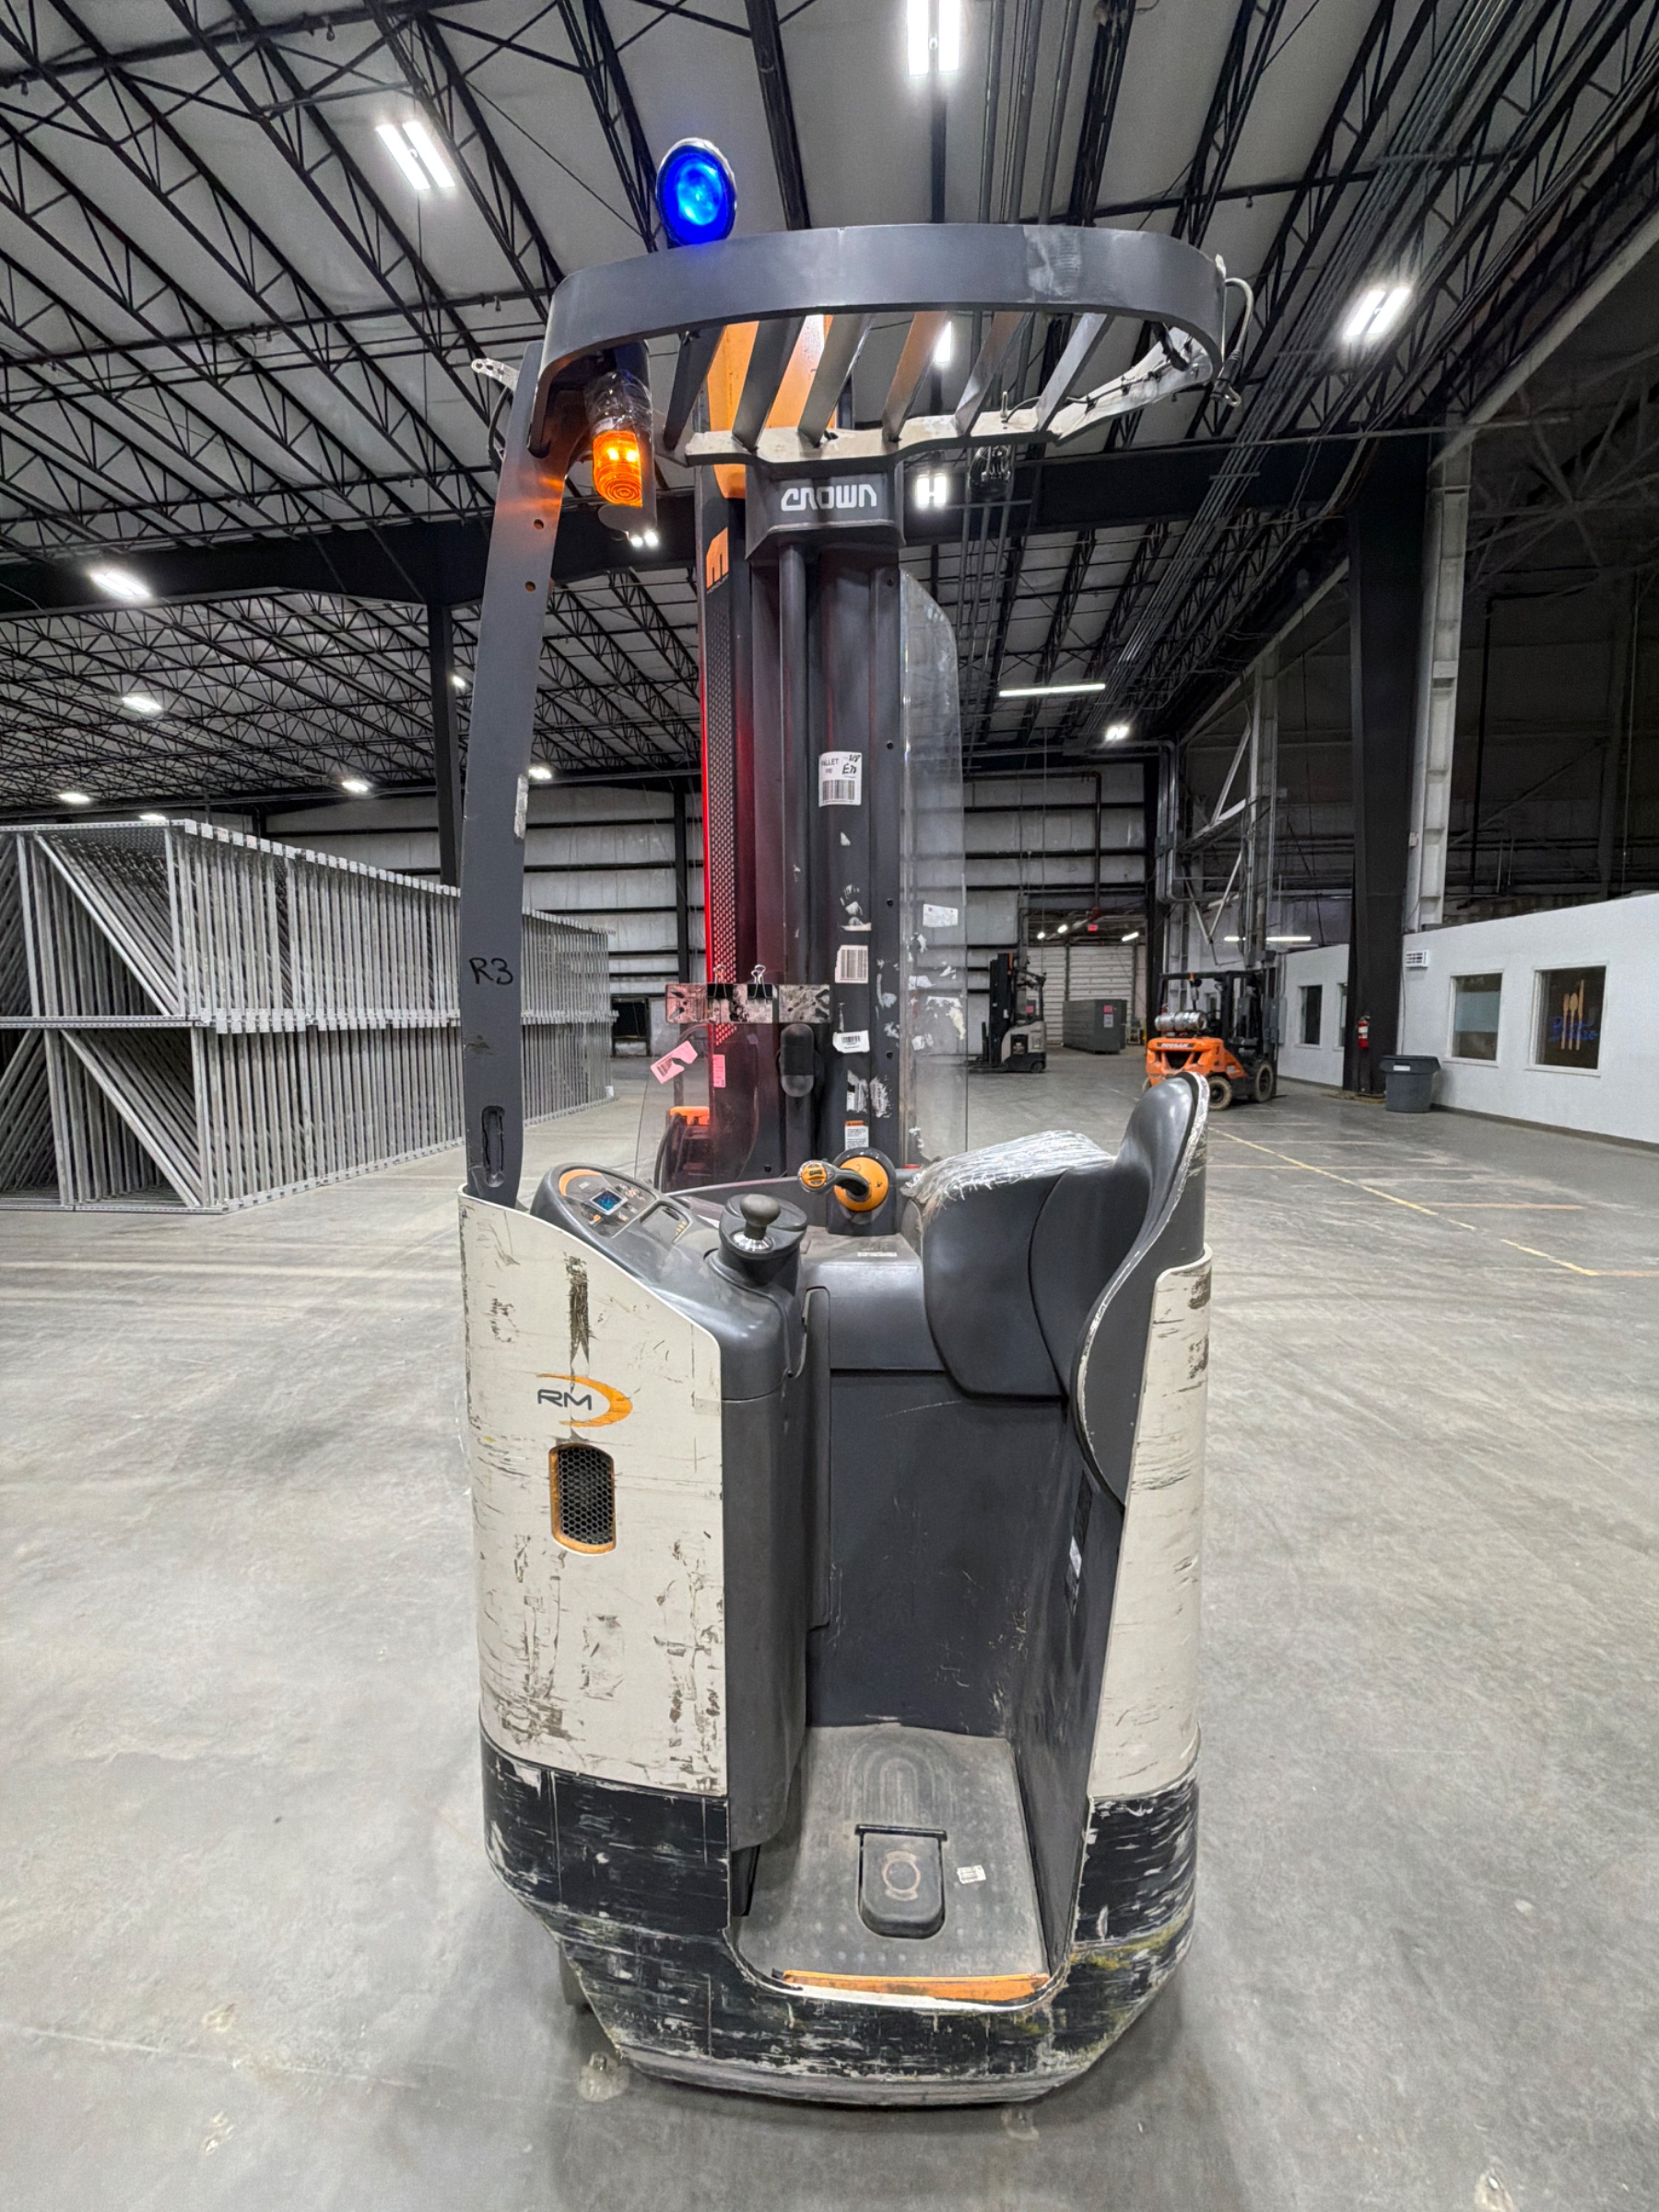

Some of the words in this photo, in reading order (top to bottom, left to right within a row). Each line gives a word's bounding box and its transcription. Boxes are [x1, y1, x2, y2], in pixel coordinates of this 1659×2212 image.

[781, 484, 877, 512] CROWN
[468, 957, 513, 985] R3
[537, 1389, 592, 1411] RM
